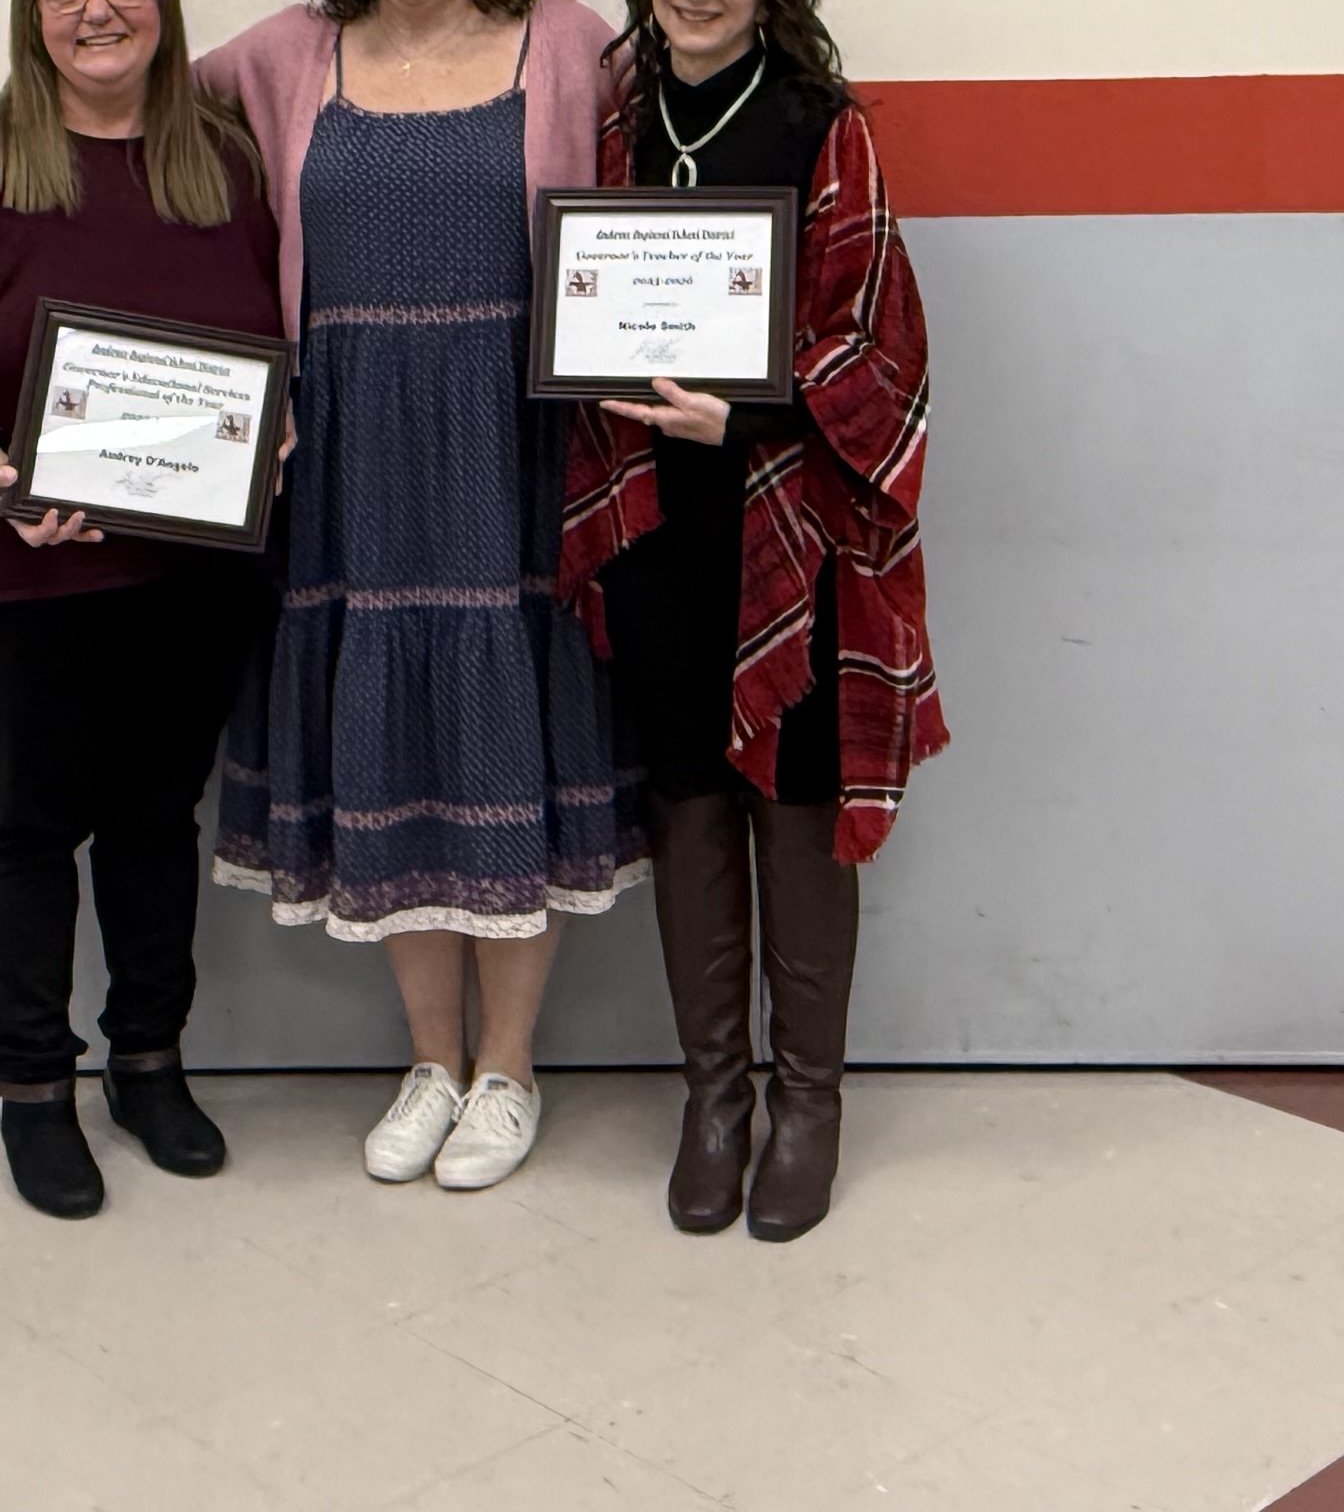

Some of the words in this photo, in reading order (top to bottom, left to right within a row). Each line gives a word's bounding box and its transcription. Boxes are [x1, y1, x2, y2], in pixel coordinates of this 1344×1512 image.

[690, 251, 703, 263] of
[726, 251, 754, 261] Year
[660, 321, 696, 331] Smith
[99, 449, 142, 467] Audrey
[146, 455, 199, 473] D'Angelo
